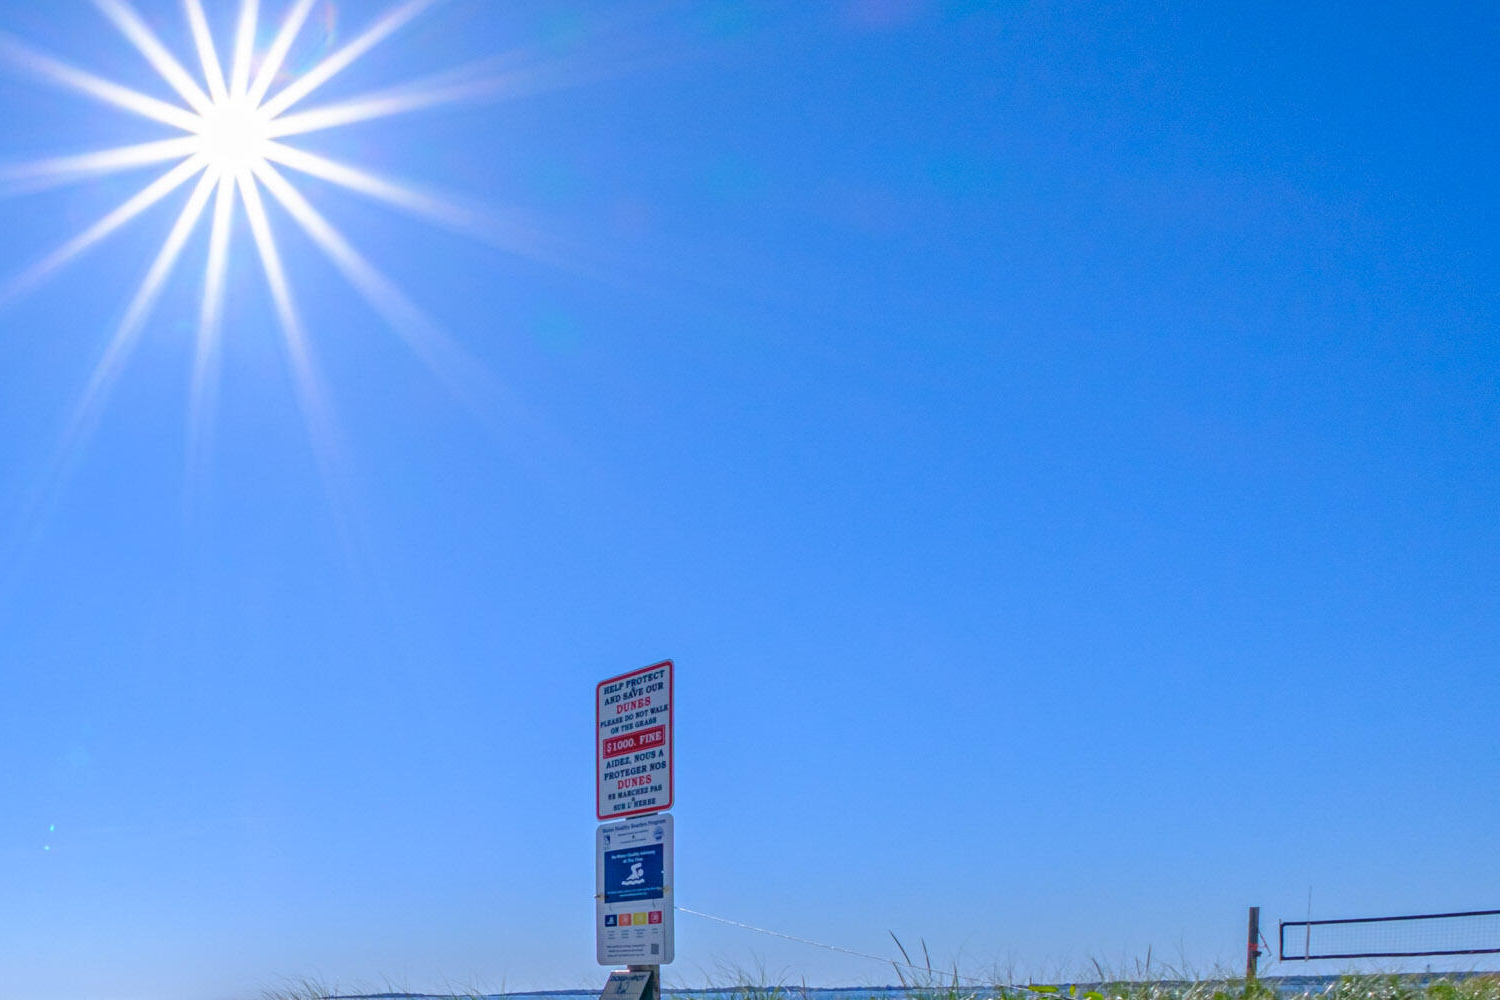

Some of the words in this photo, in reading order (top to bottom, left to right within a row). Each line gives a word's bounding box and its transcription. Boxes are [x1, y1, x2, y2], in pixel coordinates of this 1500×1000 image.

[604, 683, 624, 695] HELP
[626, 670, 665, 688] PROTECT
[604, 695, 621, 706] AND
[623, 688, 643, 700] SAVE
[646, 682, 664, 693] OUR
[616, 696, 651, 714] DUNES
[600, 717, 623, 728] PLEASE
[635, 709, 649, 718] NOT
[650, 704, 669, 714] WALK
[610, 727, 619, 735] ON
[621, 722, 633, 731] THE
[635, 717, 657, 728] GRASS
[606, 738, 636, 753] $1000.
[640, 731, 662, 745] FINE
[634, 750, 656, 763] NOUS
[658, 749, 664, 757] A
[604, 765, 647, 781] PROTEGER
[649, 761, 667, 771] NOS
[617, 775, 652, 790] DUNES
[618, 787, 648, 798] MARCHEZ
[650, 784, 662, 792] PAS
[613, 802, 625, 811] SUR
